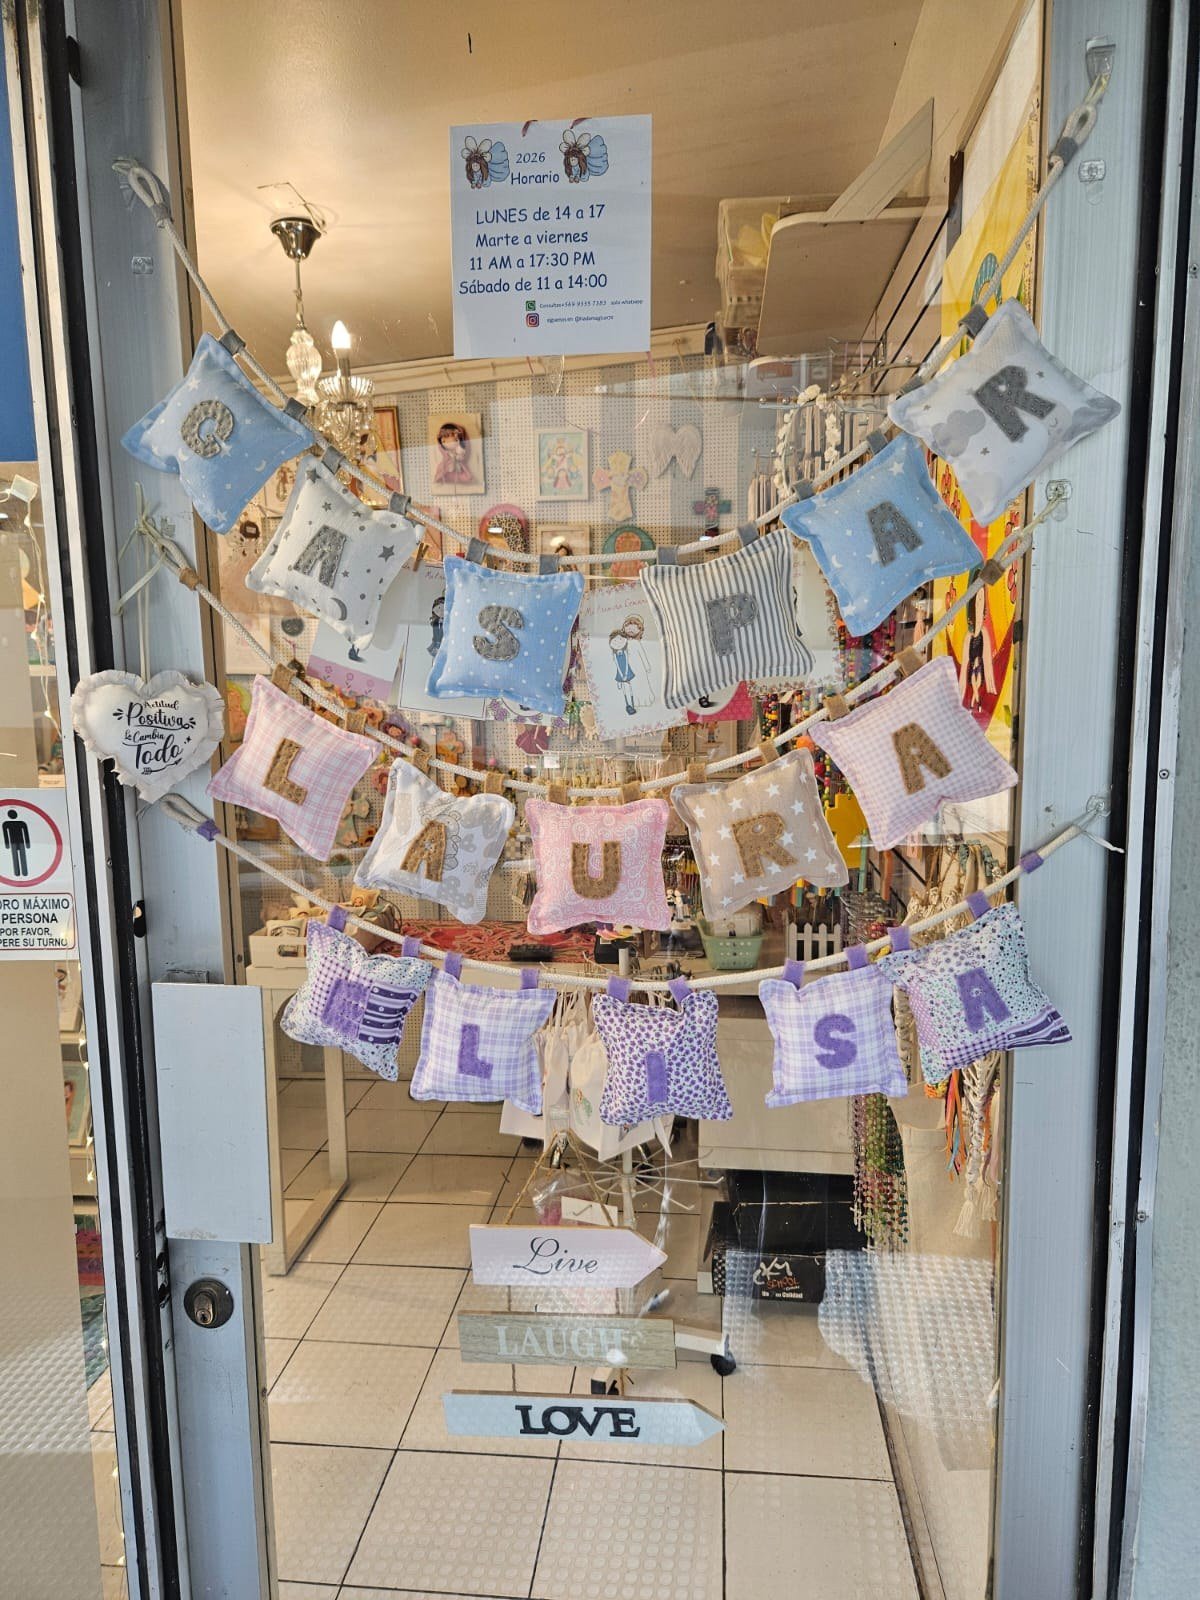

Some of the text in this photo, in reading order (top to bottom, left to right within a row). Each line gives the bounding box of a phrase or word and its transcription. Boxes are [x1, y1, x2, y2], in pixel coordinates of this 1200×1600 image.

[515, 152, 546, 164] 2026
[510, 171, 560, 185] Horario
[476, 204, 606, 225] LUNES de 14 a 17
[475, 230, 588, 248] Marte a viernes
[470, 251, 595, 271] 11 AM a 17:30 PM
[459, 273, 608, 294] Sábado de 11 a 14:00
[472, 604, 525, 662] S
[706, 592, 760, 657] P
[866, 499, 924, 567] A
[973, 364, 1057, 443] R
[143, 700, 180, 710] Actitud
[126, 702, 187, 730] Positiva
[132, 728, 165, 743] Cambia
[135, 734, 184, 769] Todo
[571, 841, 622, 899] U
[731, 812, 797, 879] R
[890, 722, 953, 796] A
[23, 896, 70, 910] MÁXIMO
[1, 912, 59, 924] PERSONA
[0, 927, 19, 937] POR
[23, 937, 35, 947] SU
[36, 937, 68, 947] TURNO
[813, 1013, 858, 1070] S
[955, 967, 1012, 1034] A
[513, 1236, 601, 1275] Live
[494, 1325, 626, 1359] LAUGH
[514, 1404, 641, 1438] LOVE
